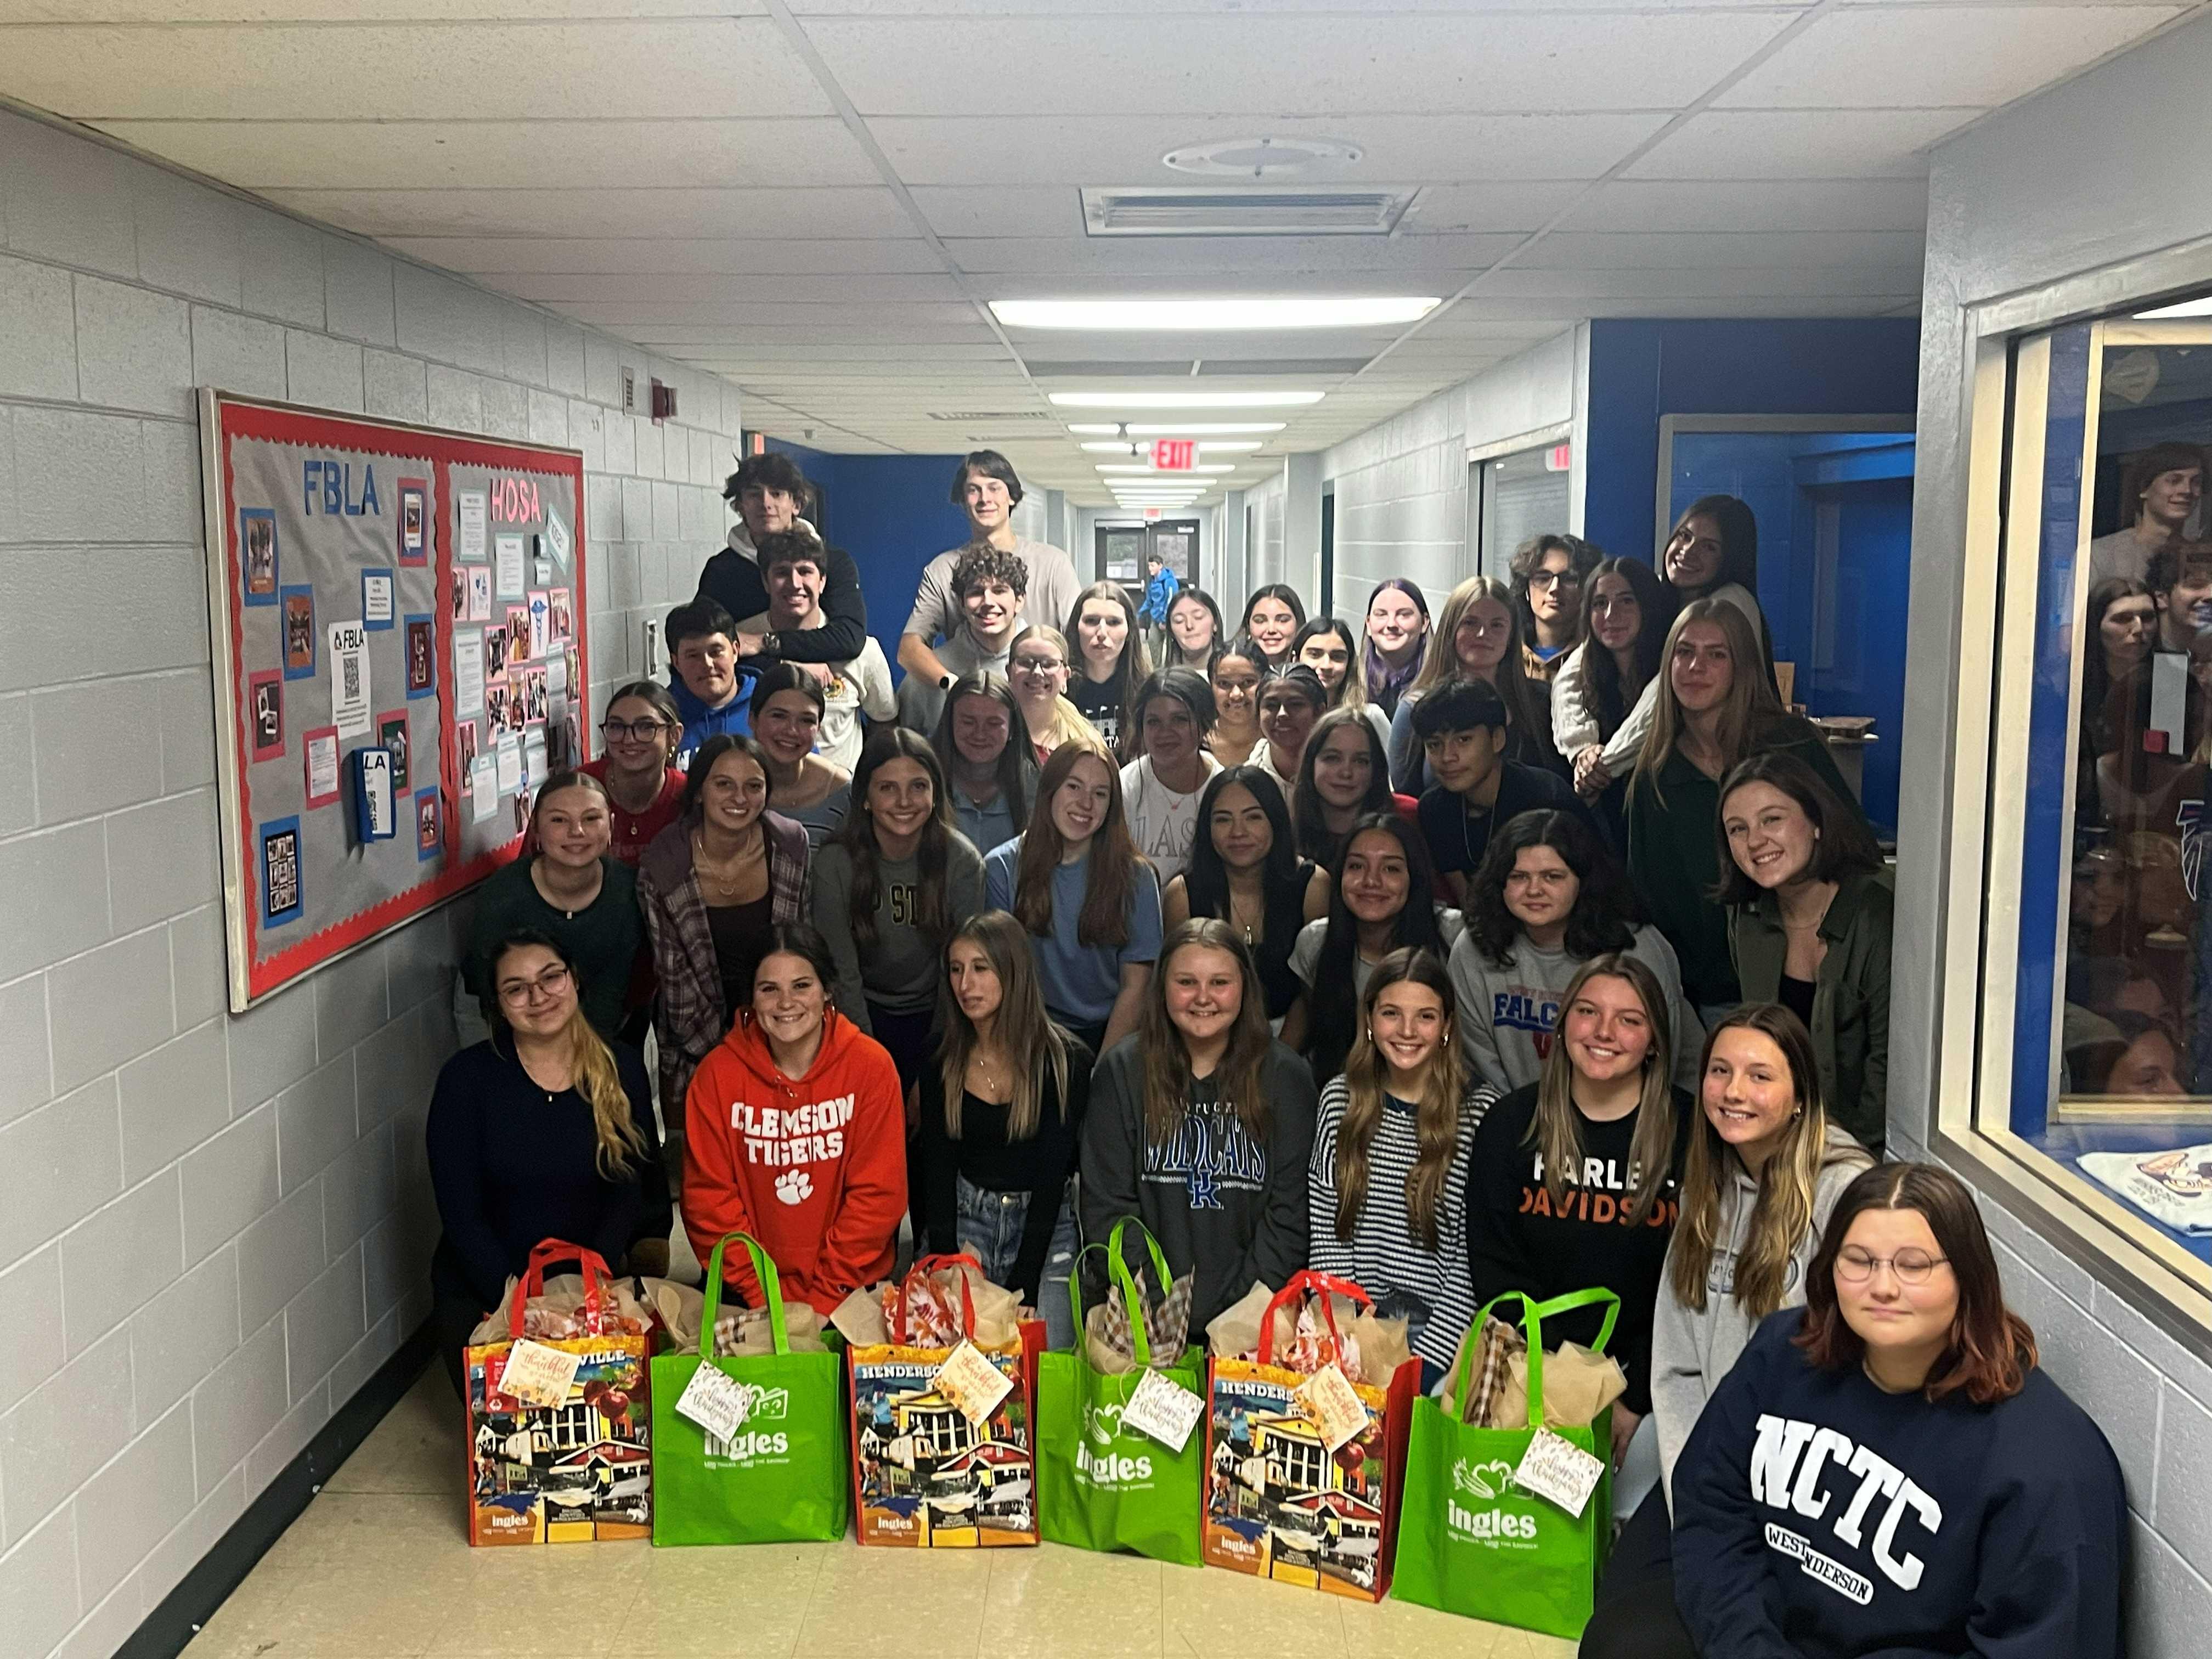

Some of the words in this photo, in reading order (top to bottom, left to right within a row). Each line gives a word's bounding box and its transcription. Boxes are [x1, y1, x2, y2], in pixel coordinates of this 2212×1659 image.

[1156, 440, 1194, 470] EXIT
[304, 460, 380, 516] FBLA
[492, 478, 541, 523] HOSA
[343, 628, 364, 650] FBLA
[364, 755, 386, 770] LA
[1494, 993, 1559, 1026] FALC
[731, 1092, 854, 1139] CLEMSON
[744, 1131, 844, 1166] TIGERS
[1750, 1413, 1943, 1592] NCTC
[1768, 1526, 1809, 1556] WEST
[1804, 1550, 1870, 1600] NDERSON
